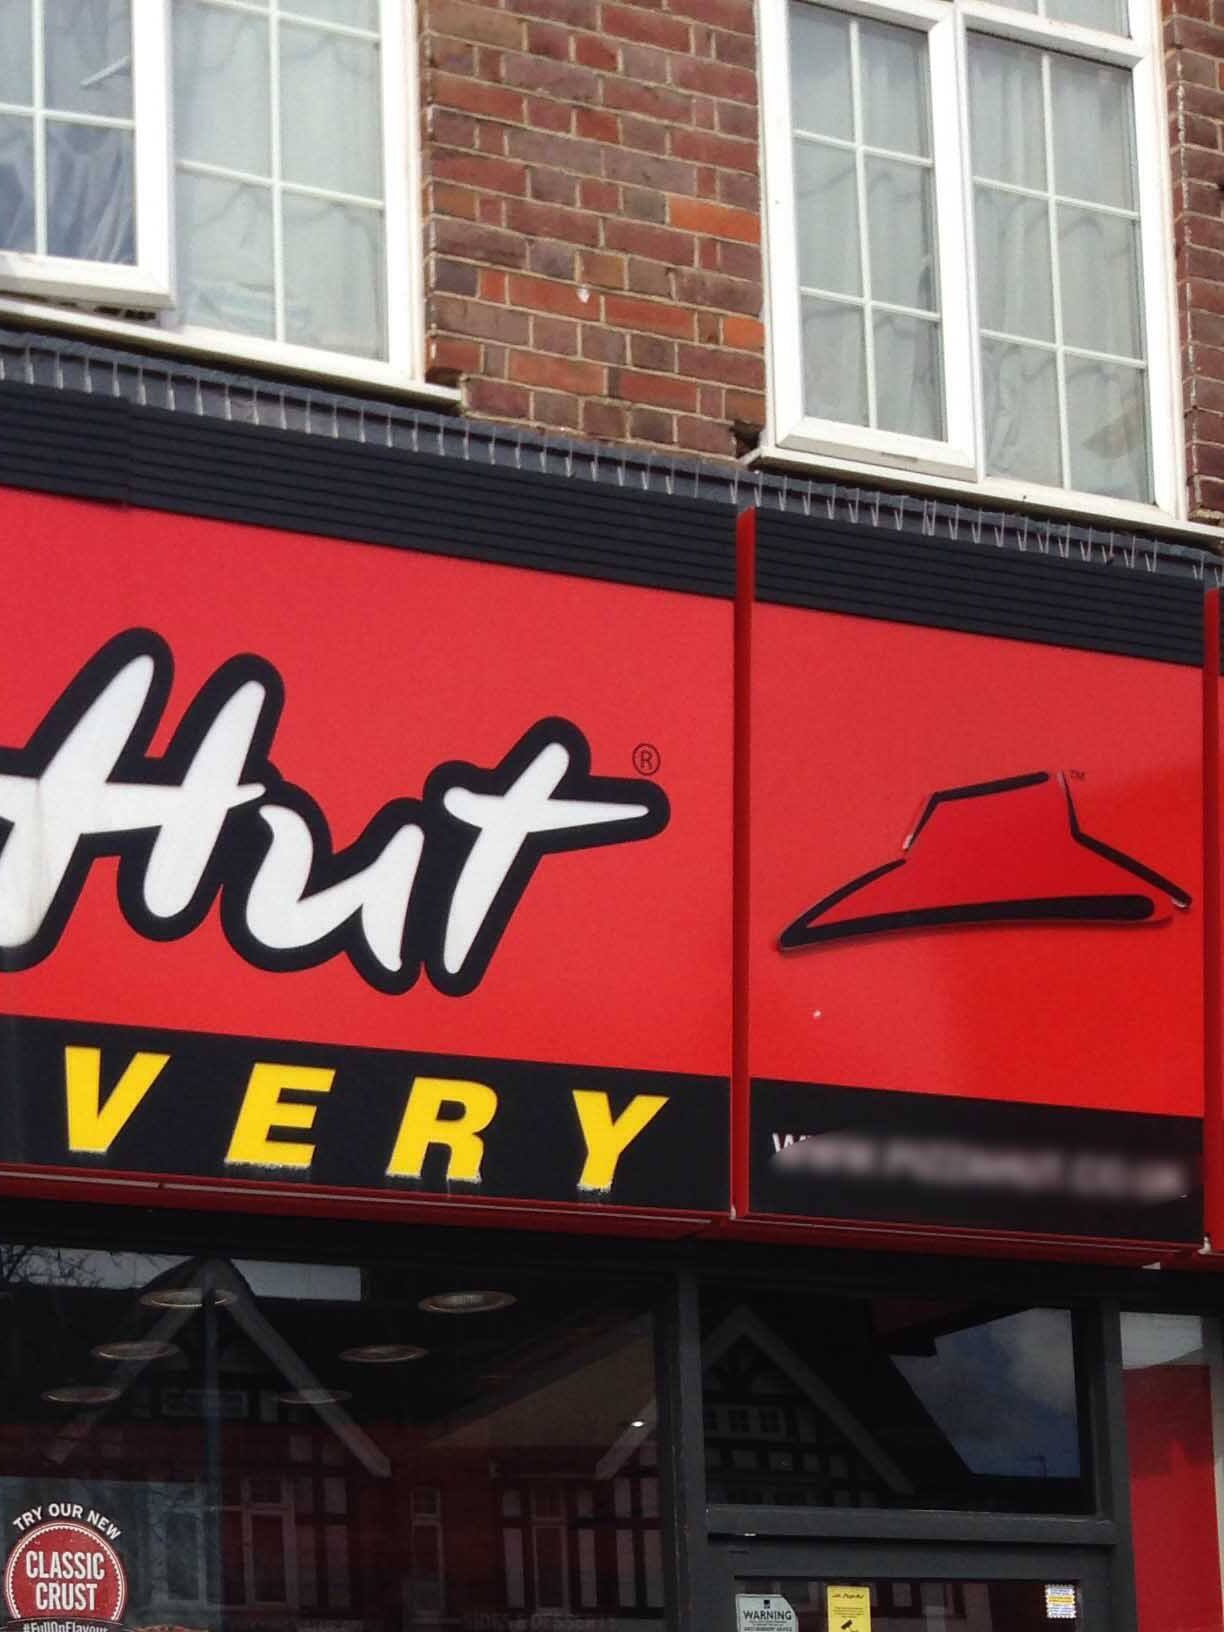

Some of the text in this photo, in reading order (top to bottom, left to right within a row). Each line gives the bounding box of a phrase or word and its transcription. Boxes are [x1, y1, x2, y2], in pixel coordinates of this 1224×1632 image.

[12, 1503, 122, 1540] TRY OUR NEW
[25, 1550, 105, 1580] CLASSIC
[36, 1582, 98, 1611] CRUST
[743, 1610, 792, 1621] WARNING
